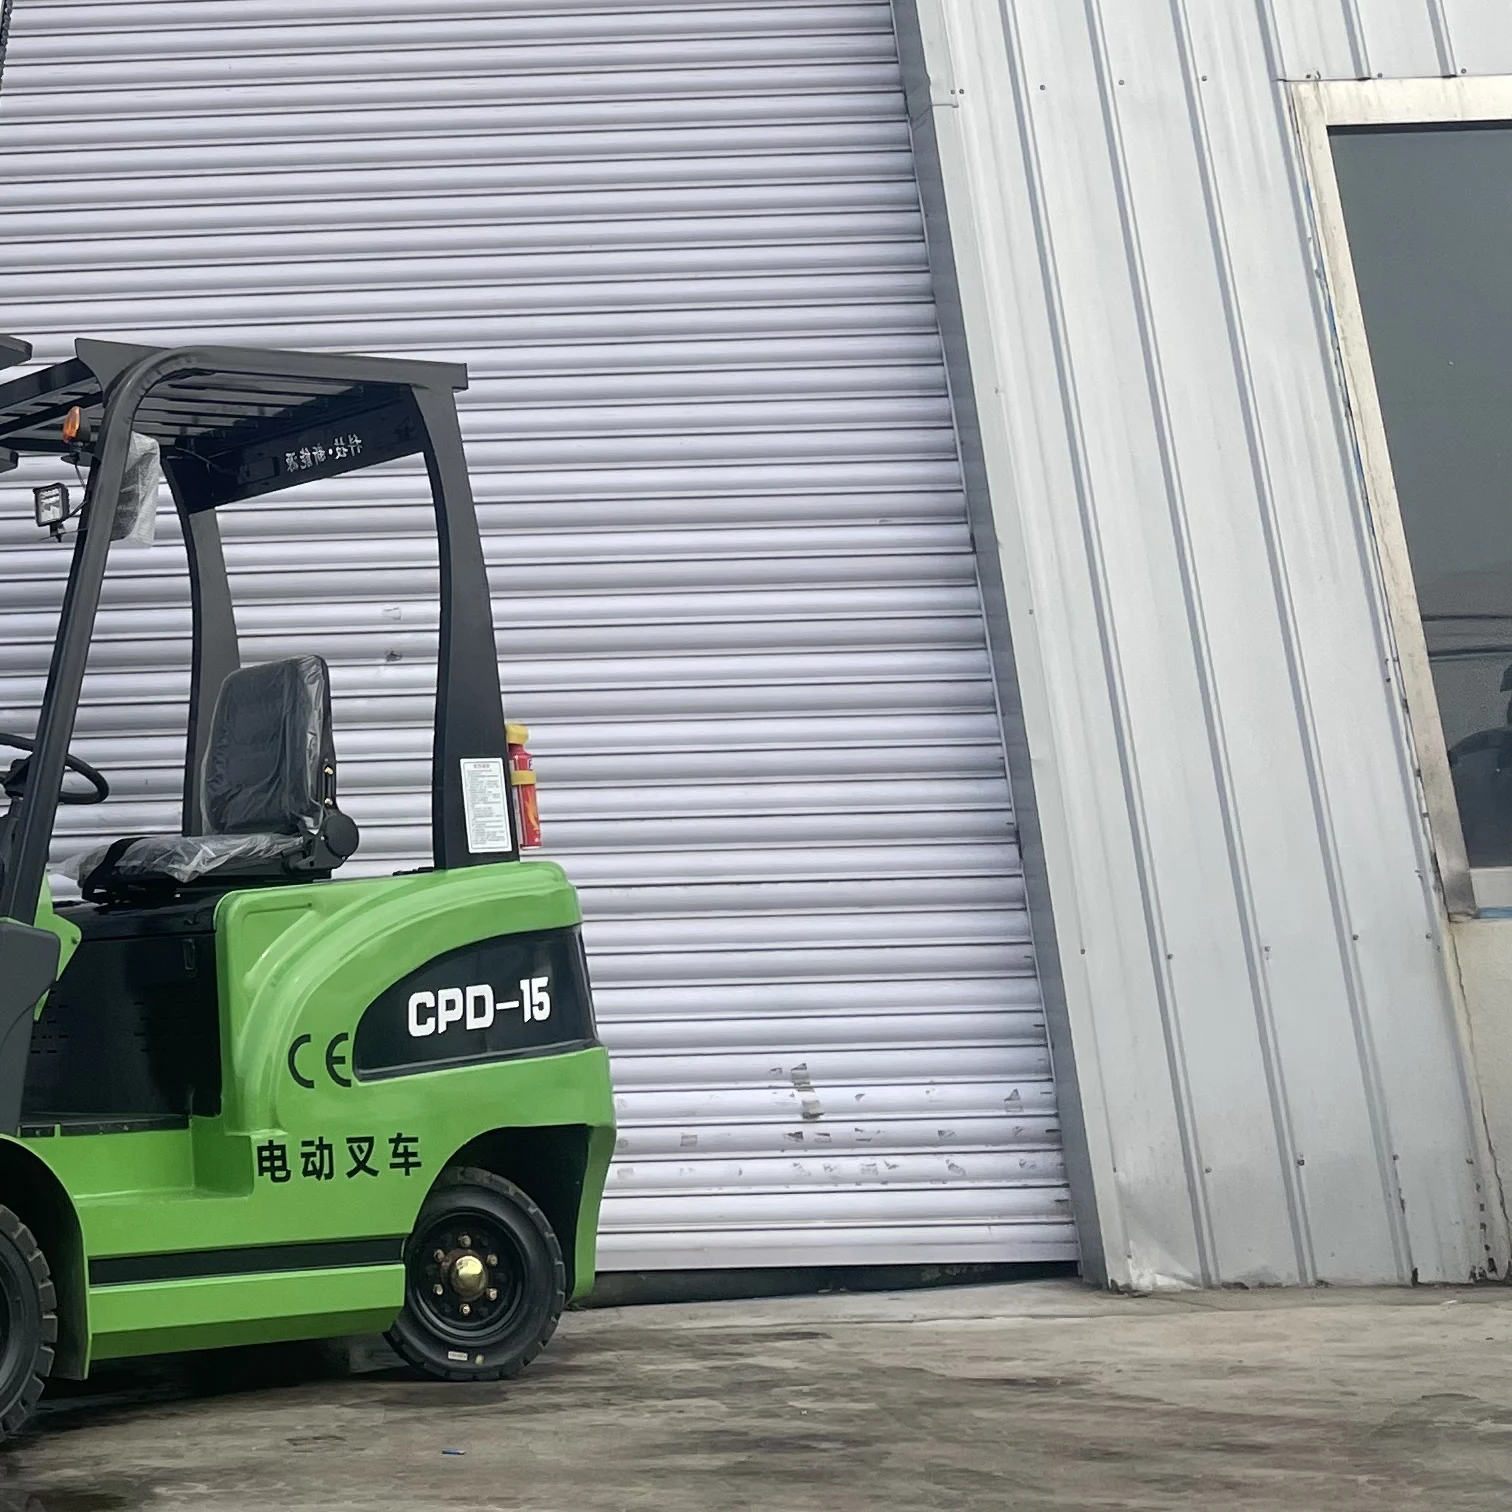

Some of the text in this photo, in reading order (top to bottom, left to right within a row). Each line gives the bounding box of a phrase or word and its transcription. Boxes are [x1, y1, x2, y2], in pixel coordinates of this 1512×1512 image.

[408, 976, 551, 1037] CPD-15
[288, 1032, 353, 1088] CE
[256, 1133, 423, 1183] 电动叉车
